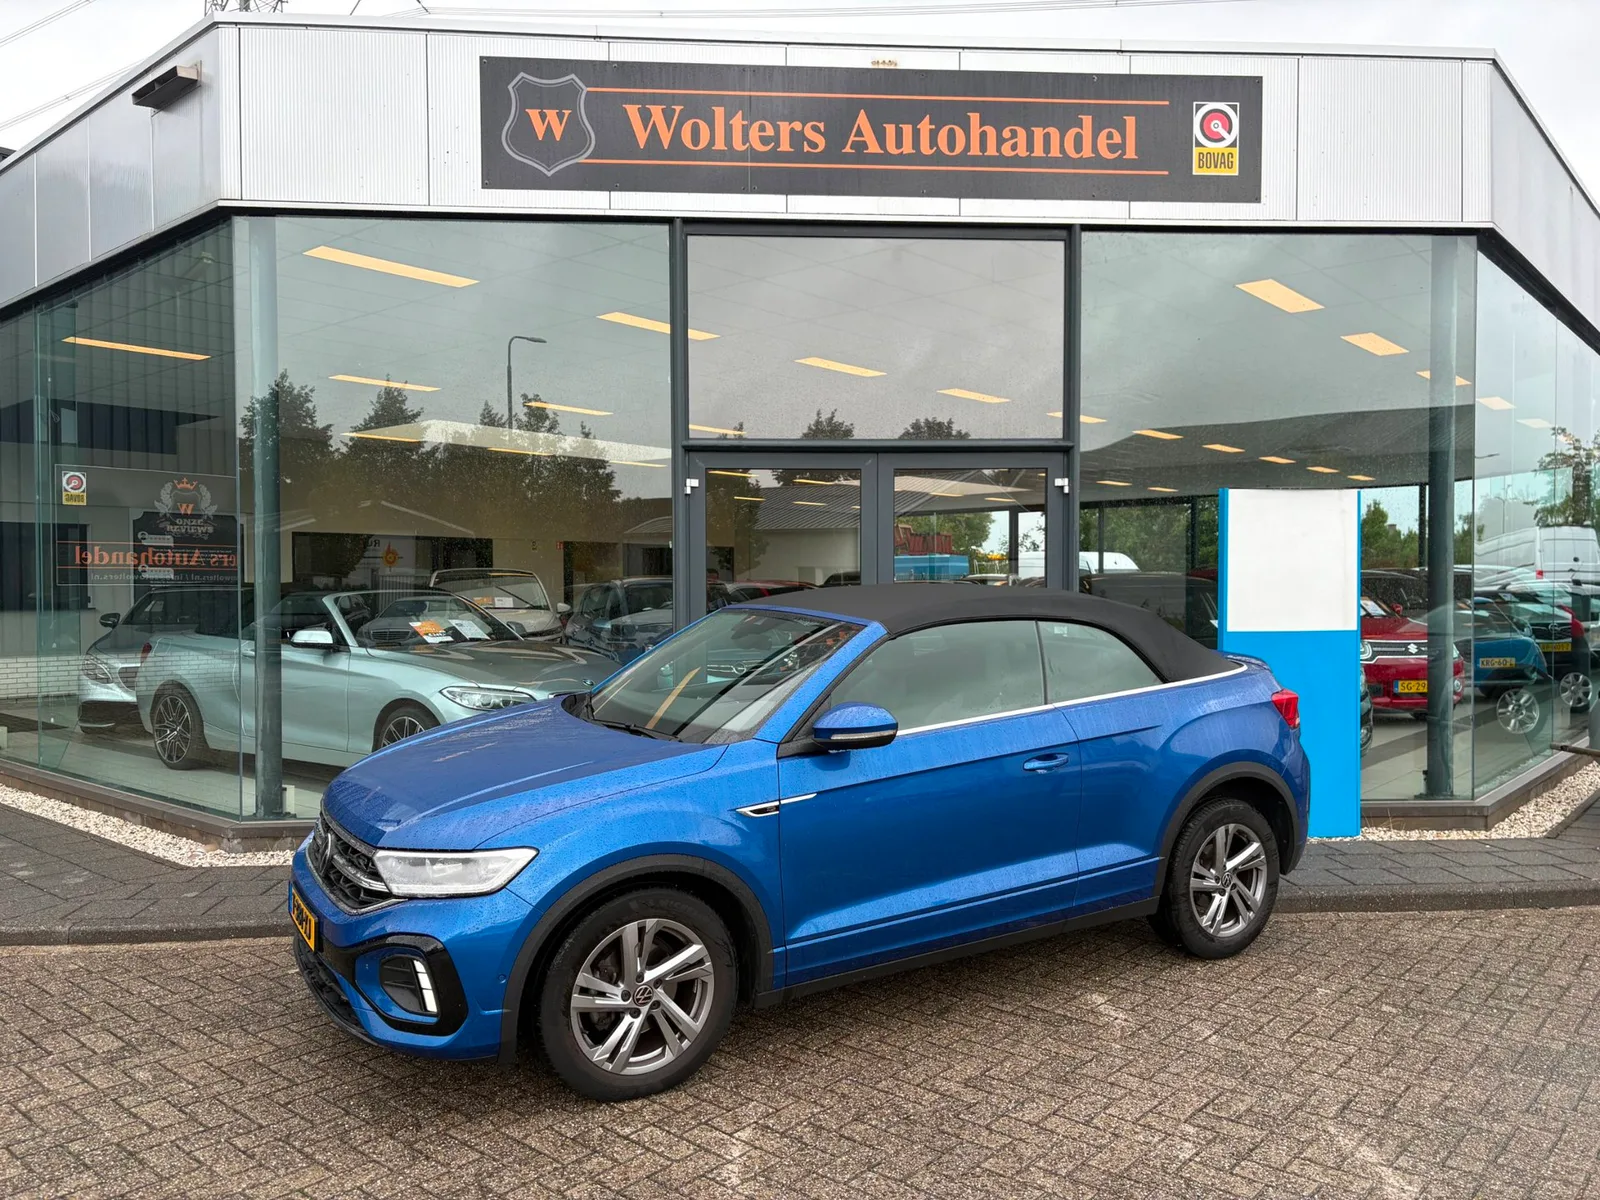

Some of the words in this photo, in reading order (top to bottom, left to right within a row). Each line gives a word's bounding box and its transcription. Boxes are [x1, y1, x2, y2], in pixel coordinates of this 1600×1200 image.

[526, 108, 571, 141] W
[623, 104, 826, 153] Wolters
[842, 110, 1138, 161] Autohandel
[1198, 151, 1234, 170] BOVAG
[166, 525, 214, 533] REVIEWS
